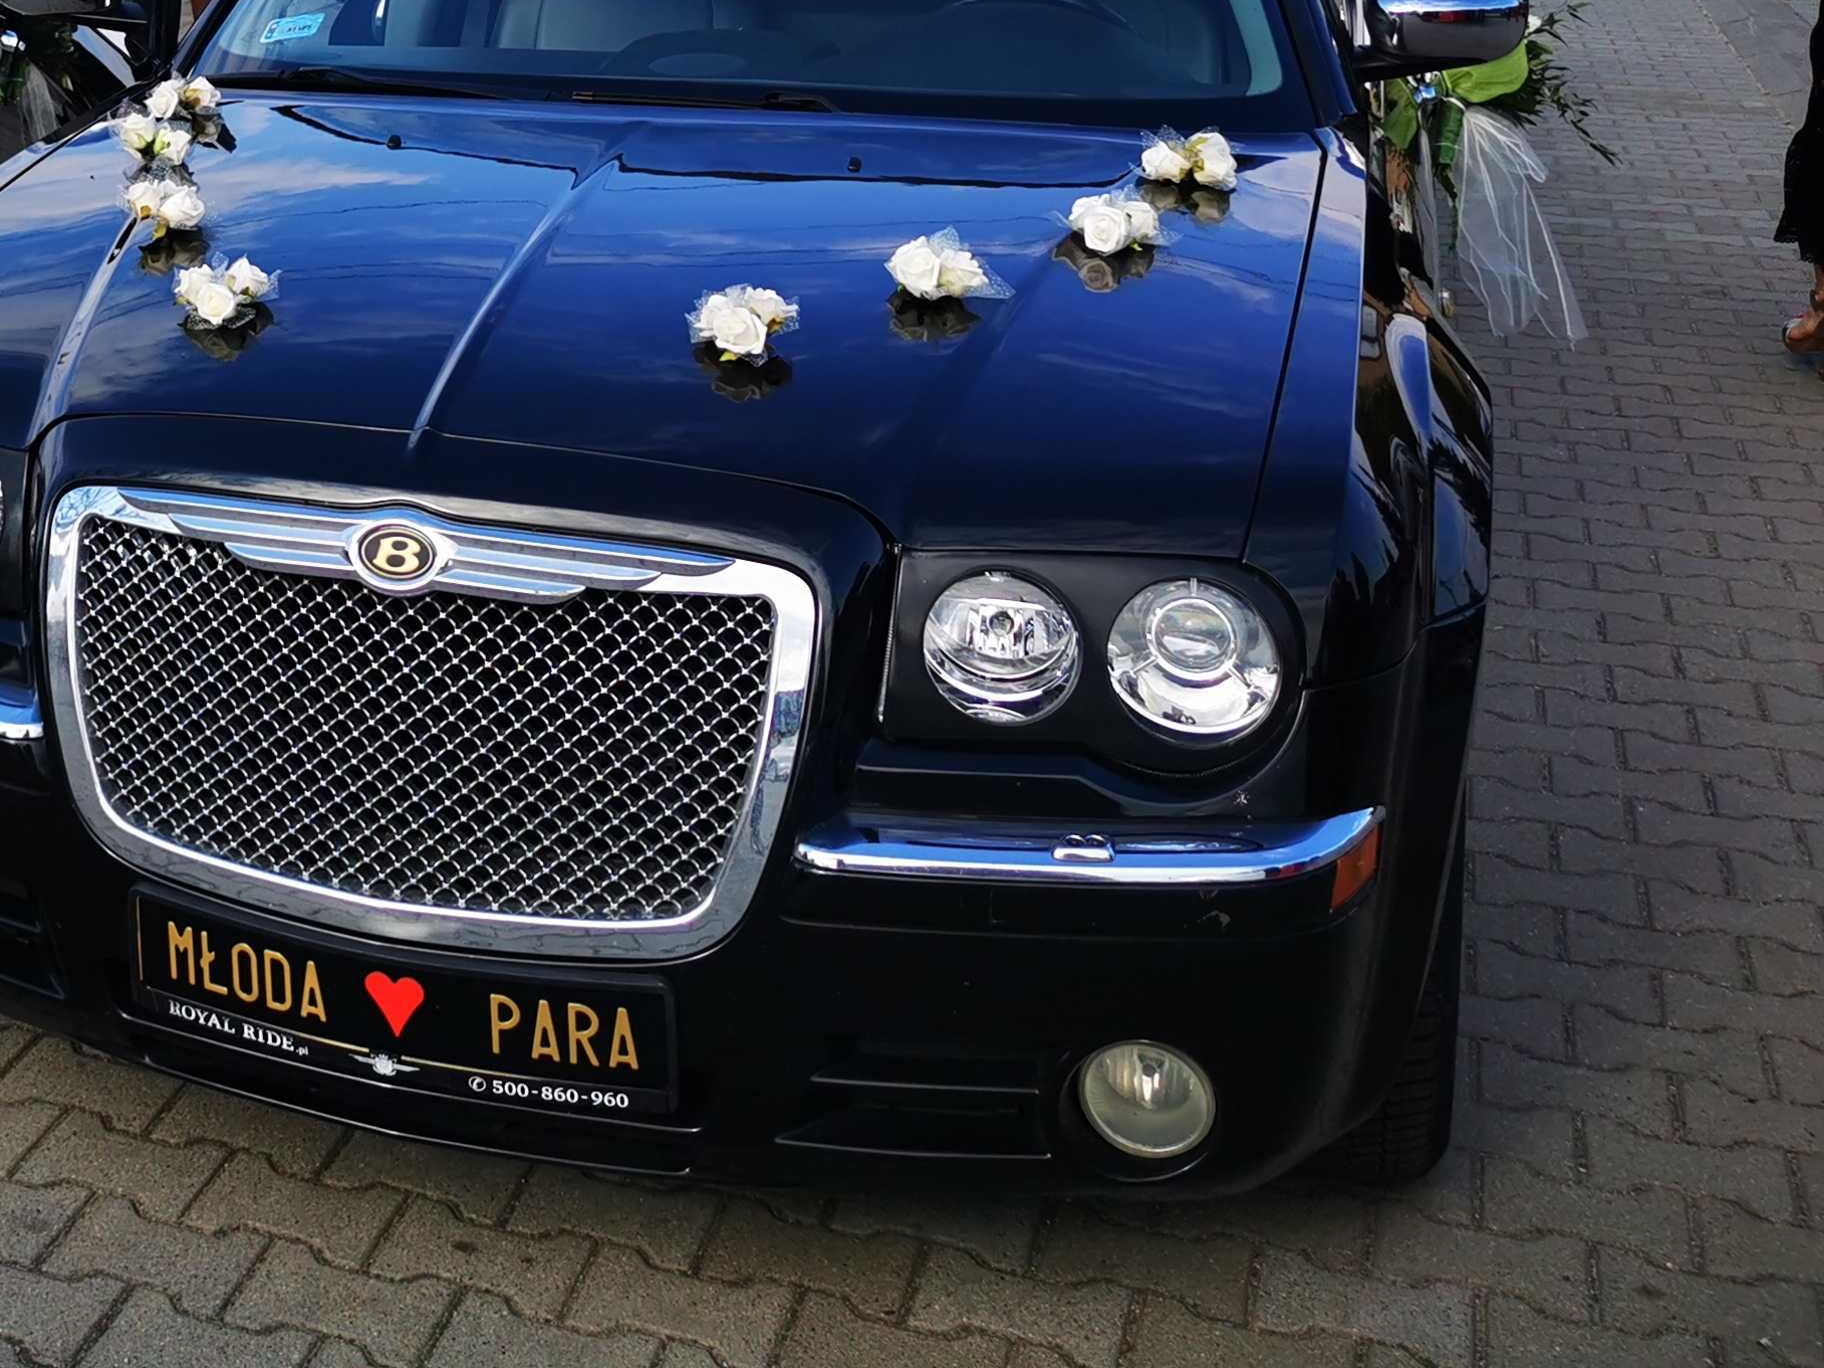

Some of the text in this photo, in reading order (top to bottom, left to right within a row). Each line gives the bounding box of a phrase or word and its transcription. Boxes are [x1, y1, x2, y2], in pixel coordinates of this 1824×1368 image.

[372, 536, 421, 574] B
[167, 920, 640, 1071] MŁODA PARA
[168, 999, 236, 1034] ROYAL
[491, 1079, 630, 1109] 500-860-960
